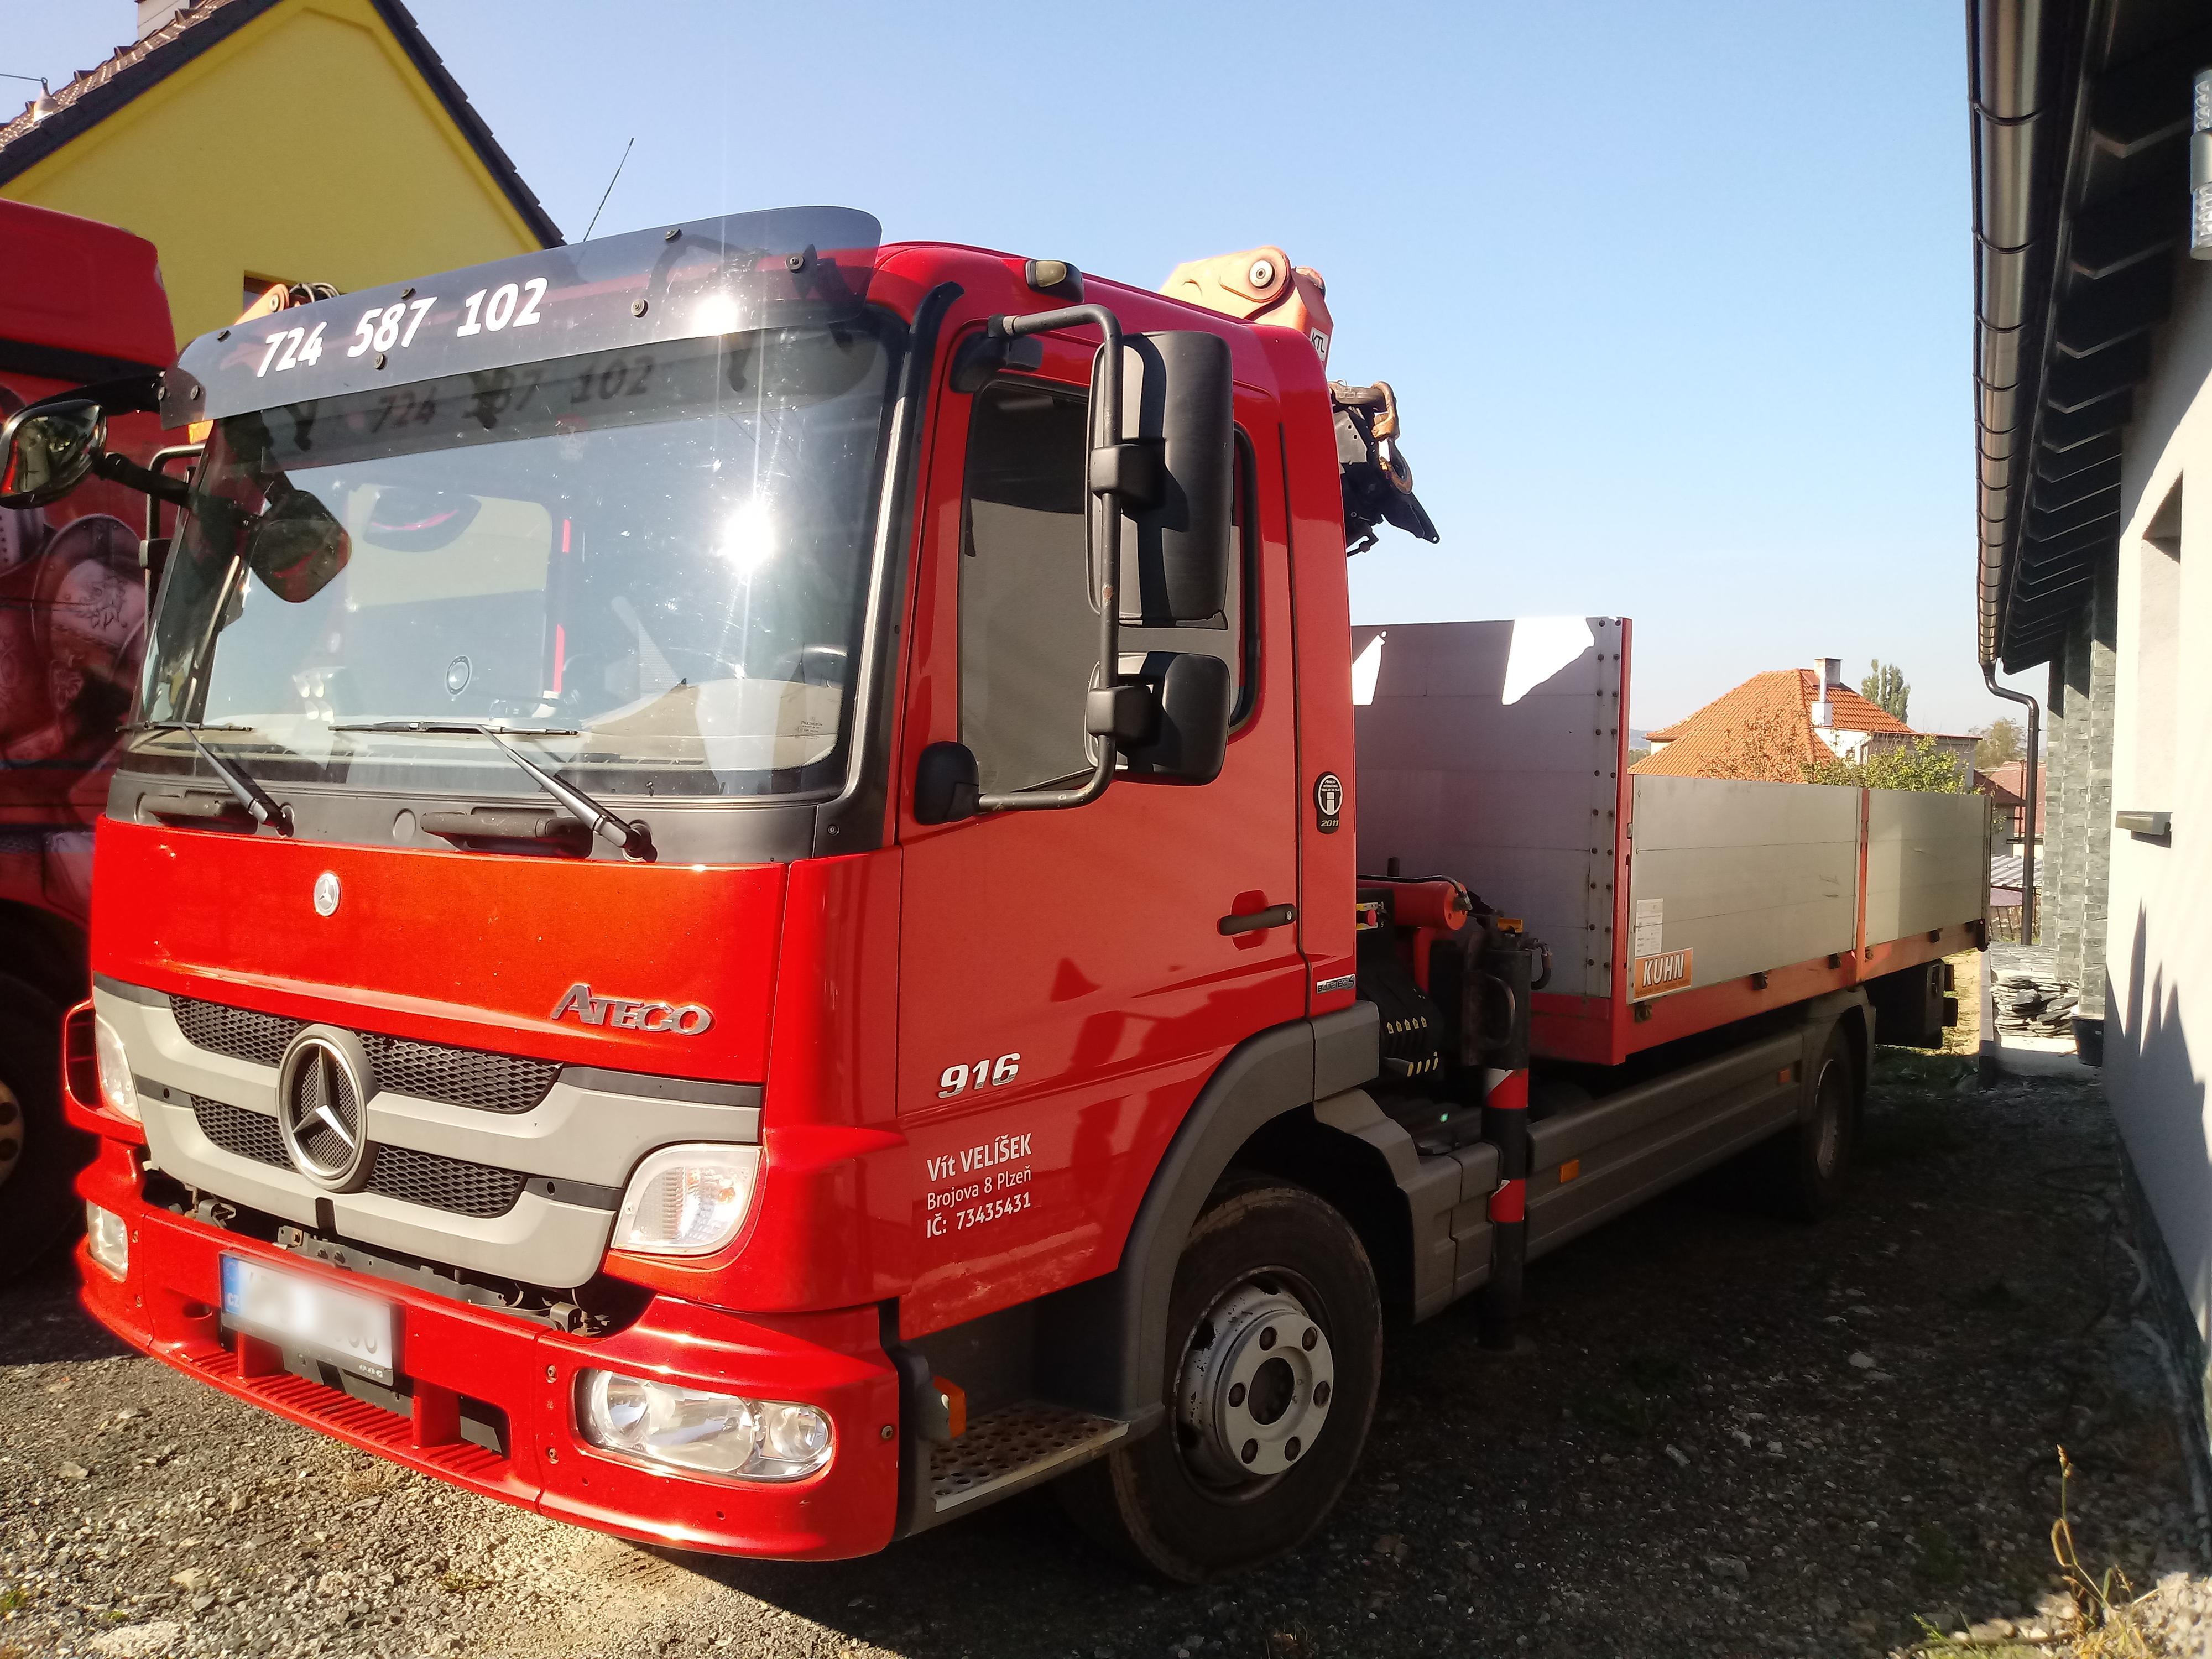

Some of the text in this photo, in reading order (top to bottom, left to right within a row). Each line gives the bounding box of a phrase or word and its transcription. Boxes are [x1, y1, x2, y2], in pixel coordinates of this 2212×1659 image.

[257, 277, 549, 378] 724 587 102
[1311, 332, 1325, 353] KTL
[570, 355, 655, 404] 102
[1642, 953, 1684, 987] KUHN
[552, 984, 714, 1036] ATEGO
[938, 1053, 1021, 1099] 916
[927, 1133, 1032, 1182] Vít VELÍŠEK
[927, 1165, 1031, 1211] Brojova 8 Plzeň
[927, 1192, 1031, 1238] IČ: 73435431
